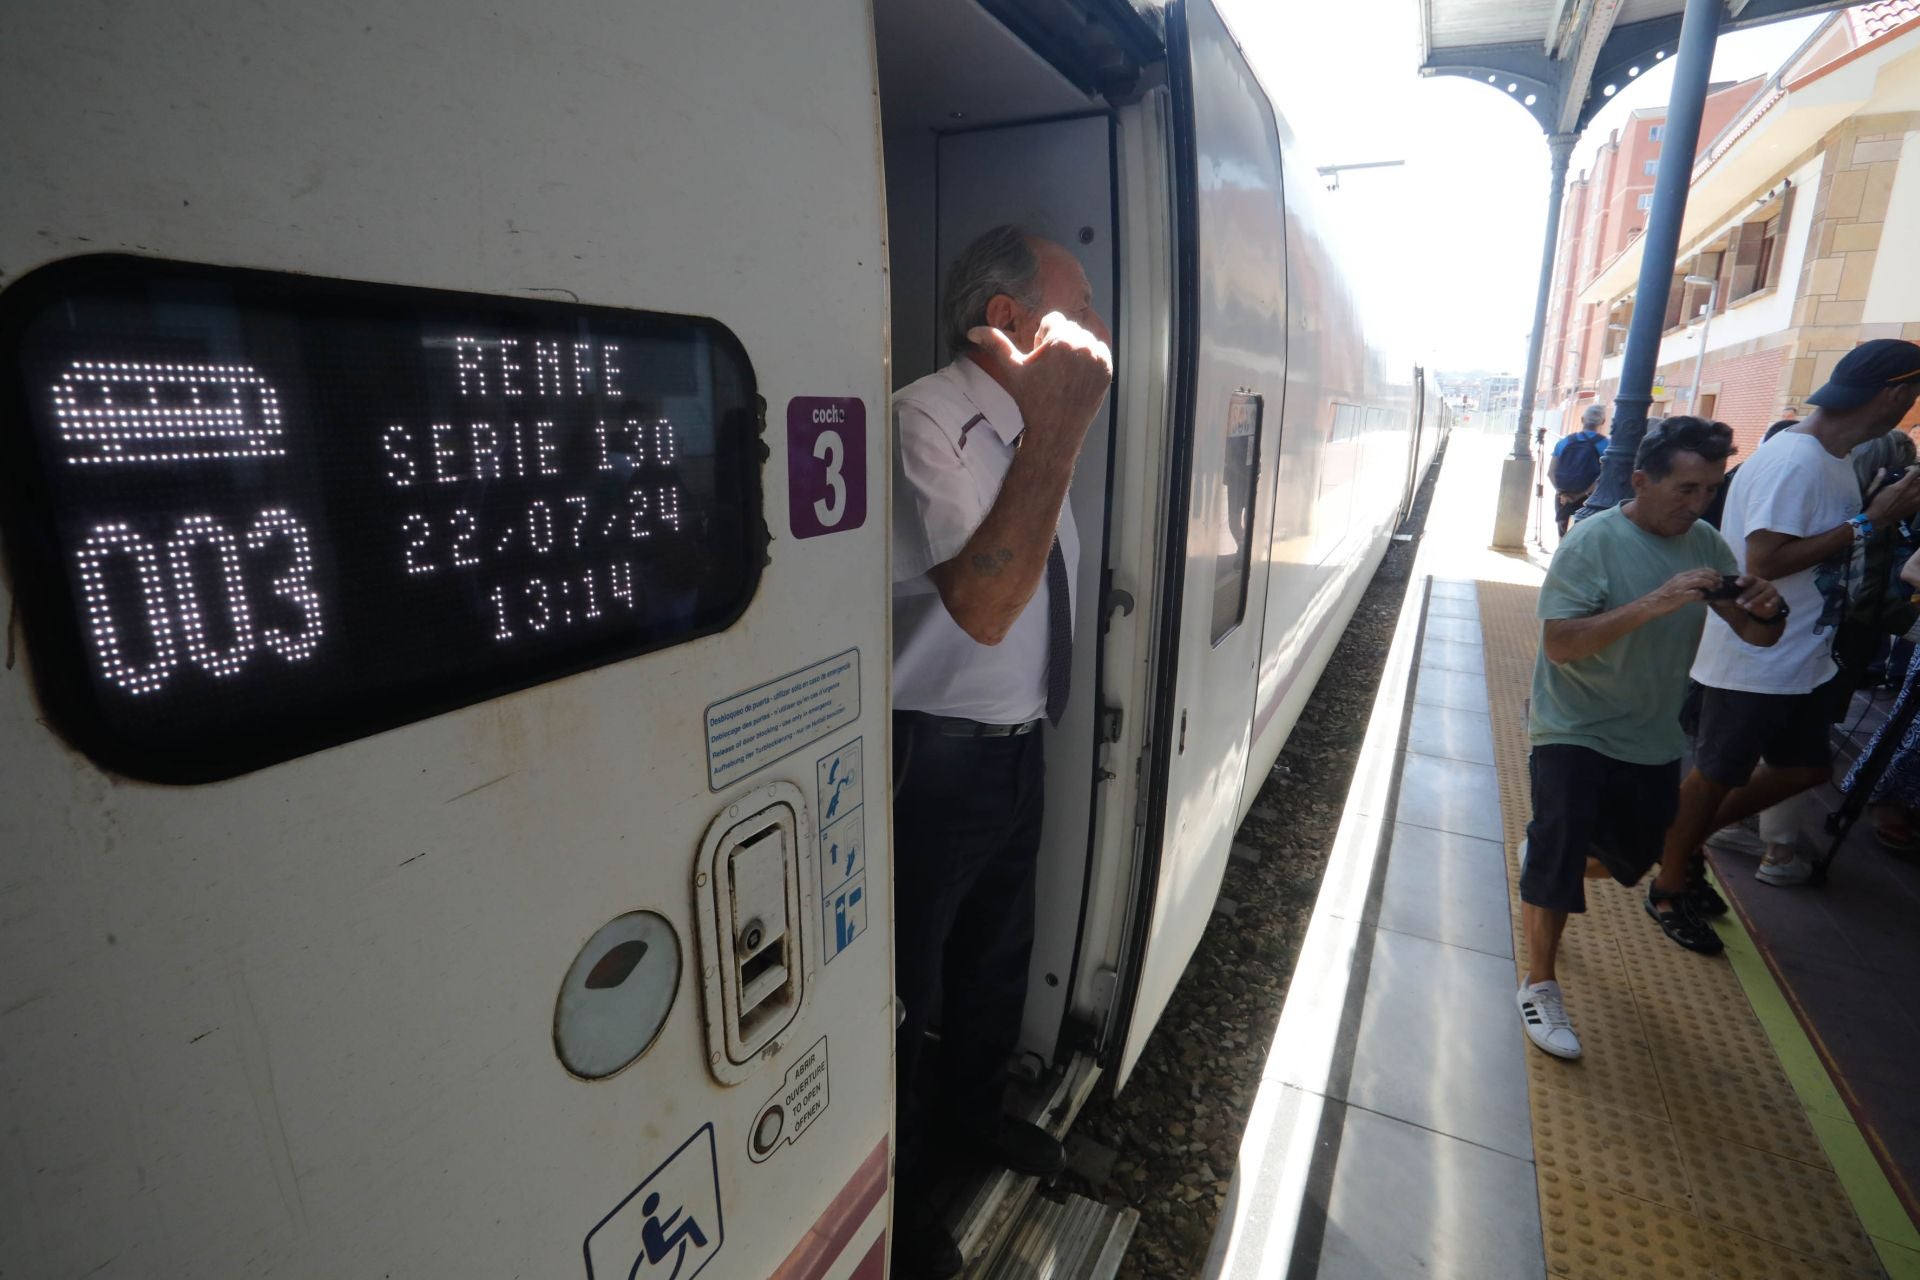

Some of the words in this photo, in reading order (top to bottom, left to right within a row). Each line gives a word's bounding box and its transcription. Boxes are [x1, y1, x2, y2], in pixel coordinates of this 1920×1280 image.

[457, 336, 622, 396] RENFE
[812, 403, 845, 423] coche
[383, 421, 558, 486] SERIE
[595, 418, 678, 470] 130
[813, 430, 847, 527] 3
[403, 487, 679, 574] 22/07/24
[77, 508, 323, 695] 003
[491, 562, 634, 641] 13:14
[710, 708, 743, 727] Desbloqueo
[785, 1061, 825, 1106] OUVERTURE
[795, 1054, 816, 1080] ABRIR
[792, 1102, 802, 1116] TO
[802, 1082, 822, 1106] OPEN
